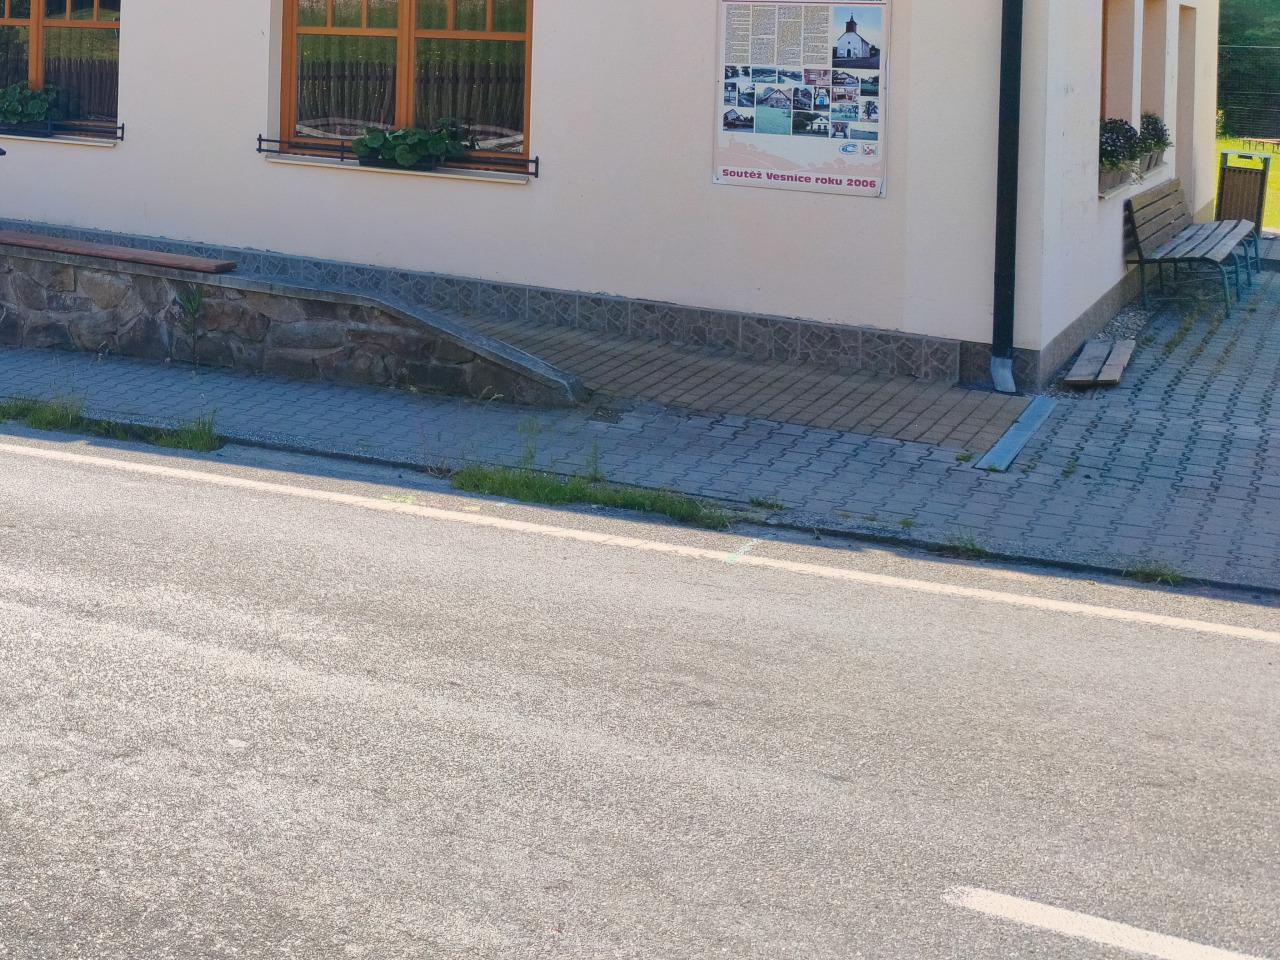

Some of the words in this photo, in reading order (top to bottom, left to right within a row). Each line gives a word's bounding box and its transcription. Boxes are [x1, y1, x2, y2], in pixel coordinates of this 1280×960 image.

[722, 168, 762, 180] Soutěž
[766, 172, 812, 184] Vesnice
[815, 177, 843, 186] roku
